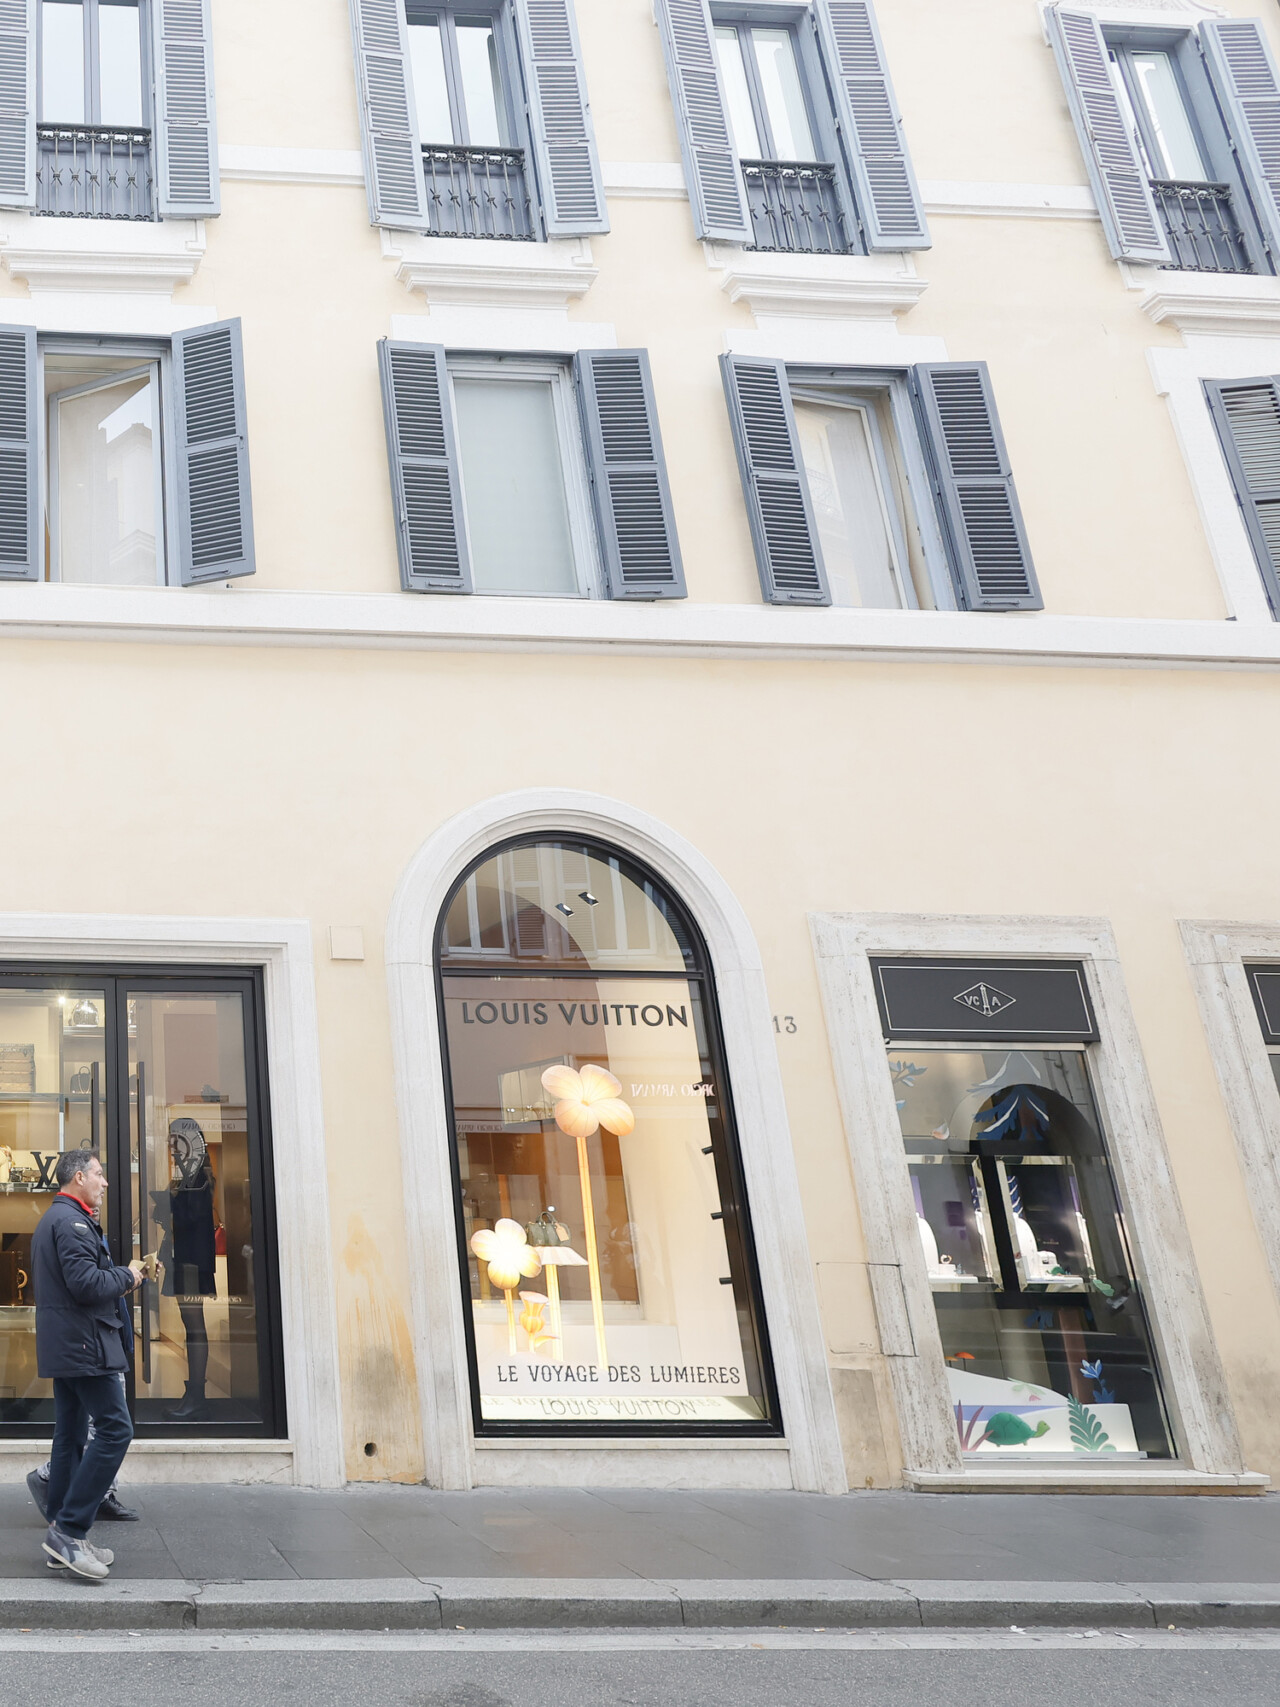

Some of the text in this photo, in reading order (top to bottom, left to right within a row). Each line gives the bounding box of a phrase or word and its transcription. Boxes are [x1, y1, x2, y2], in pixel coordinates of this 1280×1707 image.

[462, 1001, 689, 1027] LOUIS VUITTON
[771, 1015, 798, 1034] 13
[497, 1365, 741, 1384] LE VOYAGE DES LUMIERES
[540, 1399, 599, 1416] LOUIS
[611, 1399, 698, 1416] VUITTON
